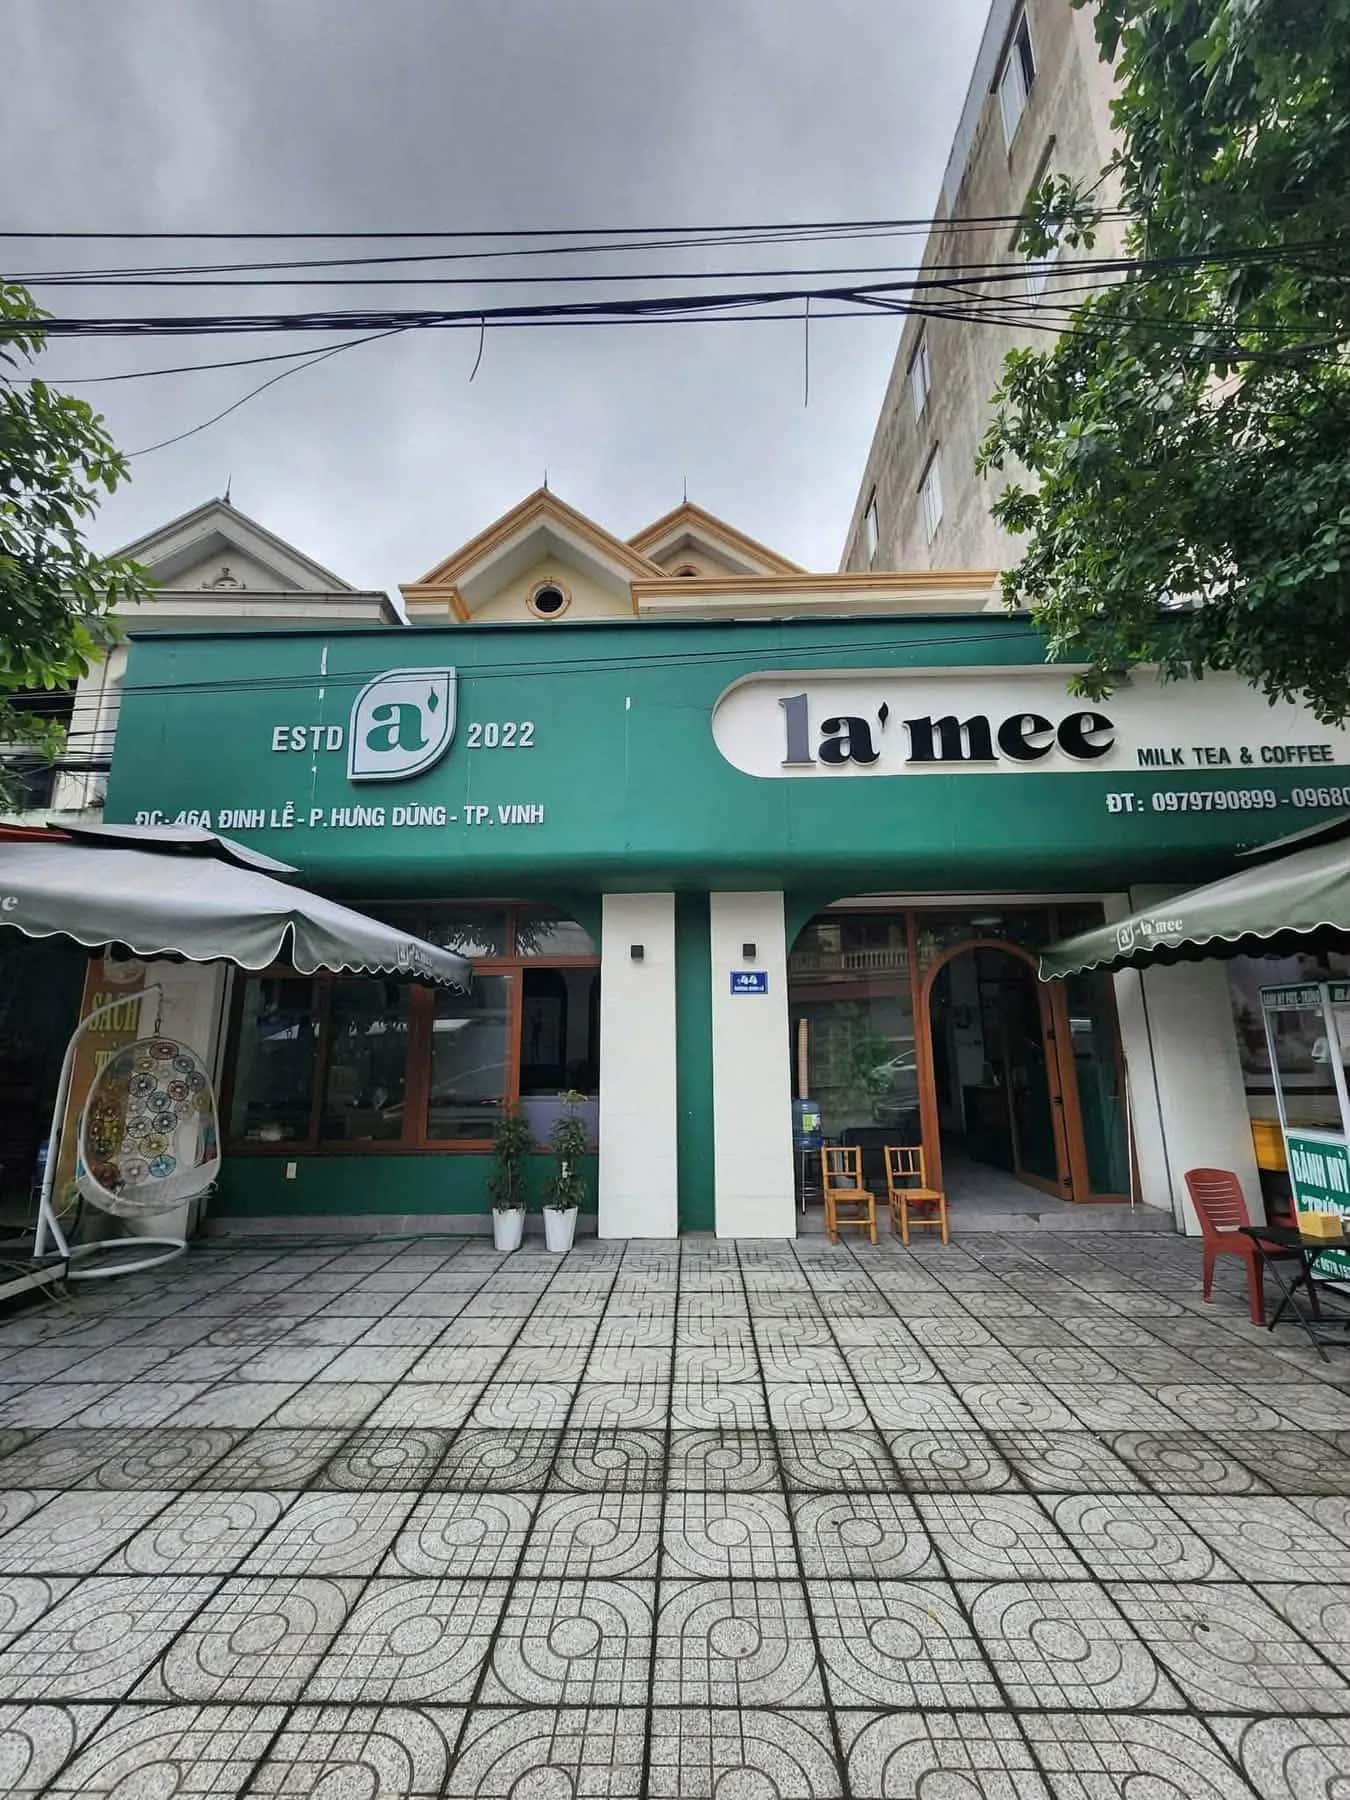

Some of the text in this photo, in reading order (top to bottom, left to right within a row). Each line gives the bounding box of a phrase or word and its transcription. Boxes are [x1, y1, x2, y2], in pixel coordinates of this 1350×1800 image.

[271, 726, 344, 751] ESTD
[467, 722, 535, 748] 2022
[778, 692, 1116, 767] la'mee
[1136, 745, 1334, 766] MILK TEA & COFFEE
[174, 810, 212, 829] 46A
[218, 809, 265, 829] ĐINH
[270, 801, 294, 828] LỄ
[391, 802, 446, 827] DŨNG
[498, 804, 544, 825] VINH
[1106, 793, 1144, 812] ĐT:
[1152, 790, 1276, 811] 0979790899
[1291, 1143, 1328, 1189] BÁNH
